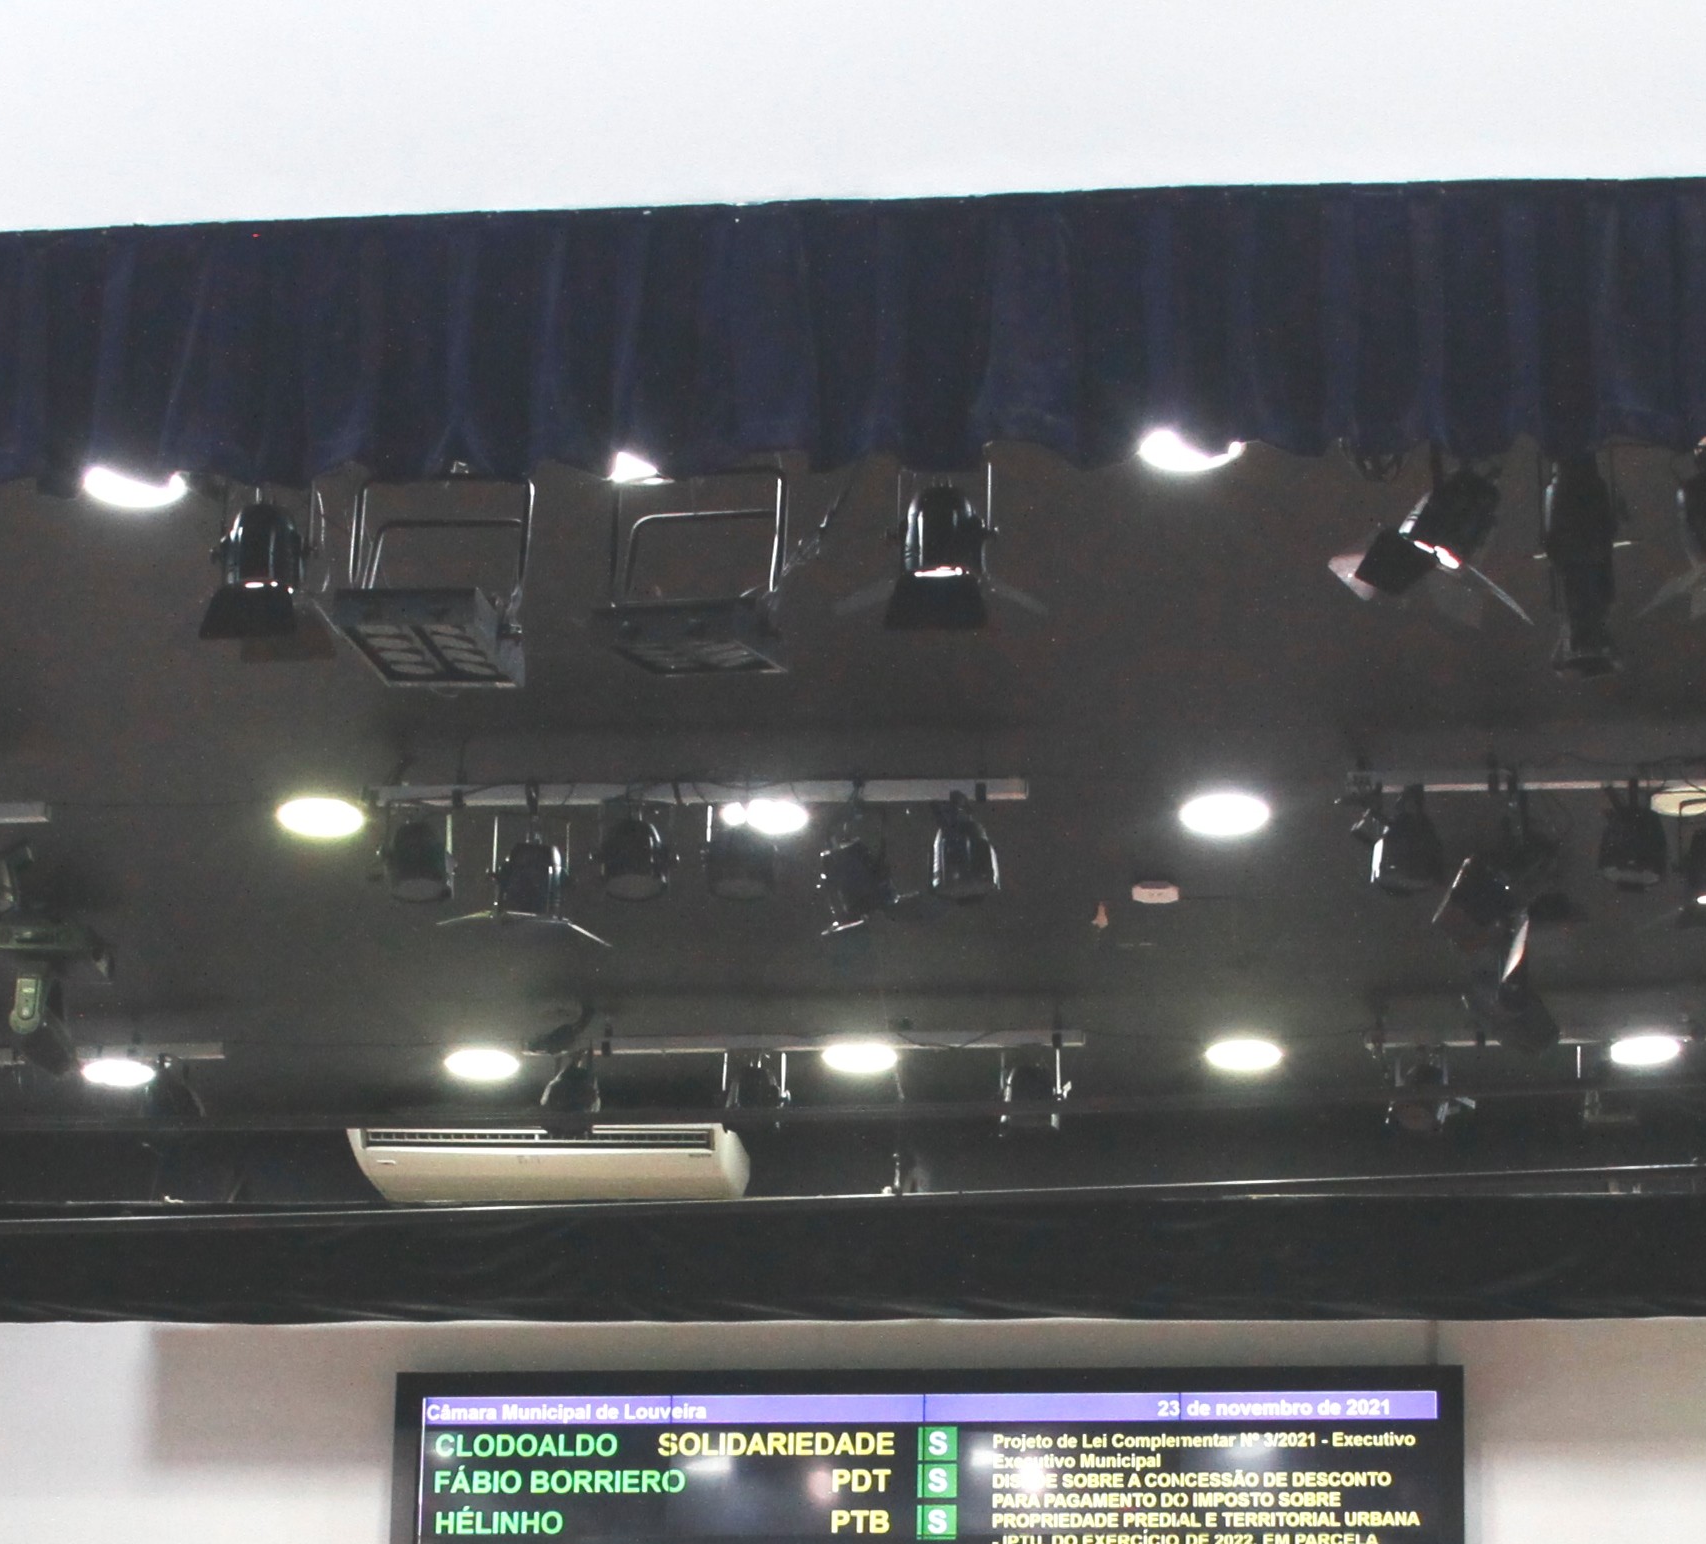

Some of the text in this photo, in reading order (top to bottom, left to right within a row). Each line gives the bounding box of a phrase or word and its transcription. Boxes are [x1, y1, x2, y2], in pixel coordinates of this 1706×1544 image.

[427, 1403, 706, 1424] Câmara Municipal de Louveira
[1158, 1398, 1390, 1417] 23 de novembro de 2021
[436, 1432, 948, 1458] CLODOALDO SOLIDARIEDADE S
[993, 1433, 1053, 1452] Projeto
[1057, 1433, 1077, 1449] de
[1082, 1433, 1107, 1449] Lei
[1112, 1432, 1235, 1451] Complementar
[1240, 1432, 1259, 1448] Nº
[1264, 1432, 1316, 1448] 3/2021
[1332, 1432, 1415, 1447] Executivo
[1081, 1453, 1161, 1471] Municipal
[435, 1467, 948, 1494] FÁBIO BORRIERO PDT S
[993, 1469, 1391, 1488] DISE SOBRE A CONCESSÃO DE DESCONTO
[993, 1492, 1341, 1508] PARA PAGAMENTO DO IMPOSTO SOBRE
[435, 1506, 947, 1535] HÉLINHO PTB S
[993, 1511, 1420, 1528] PROPRIEDADE PREDIAL E TERRITORIAL URBANA
